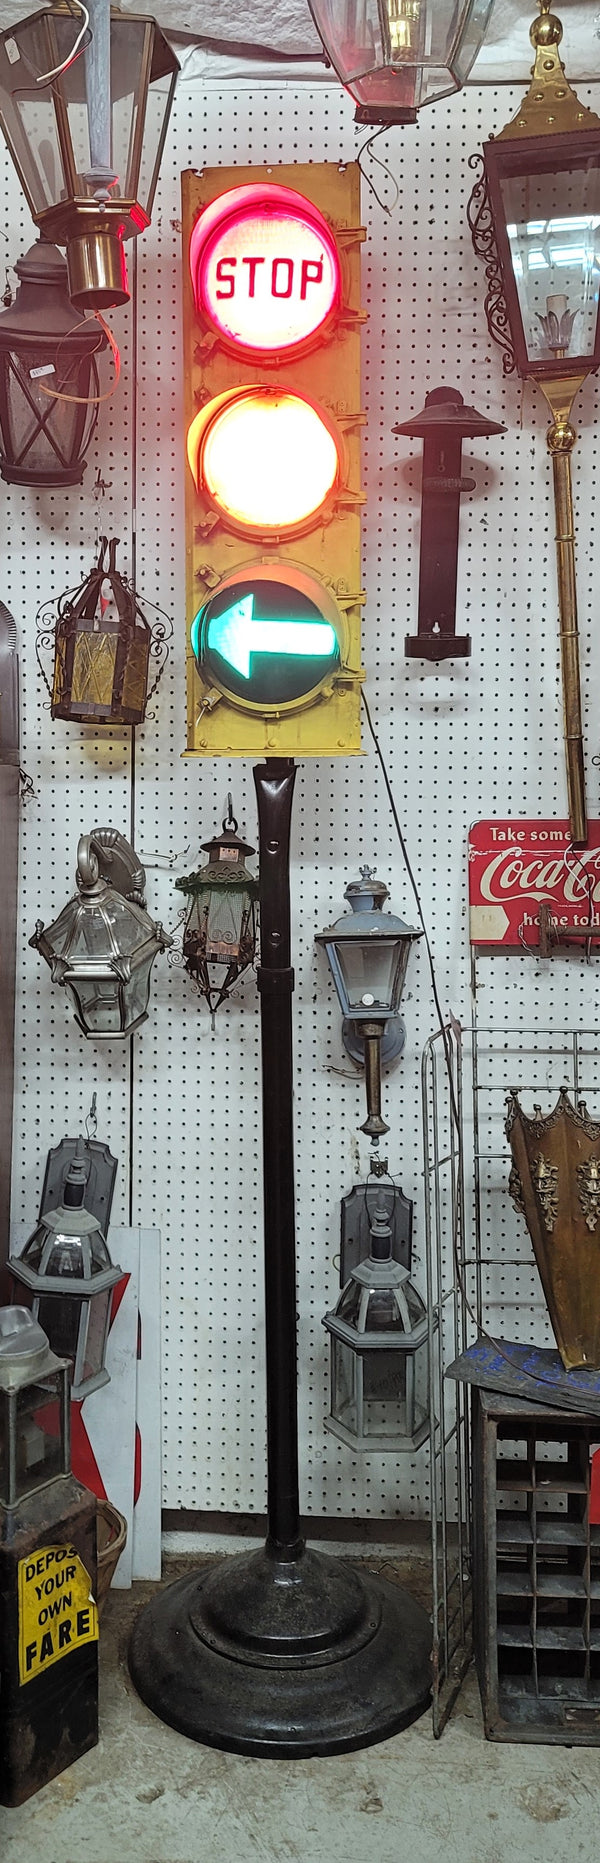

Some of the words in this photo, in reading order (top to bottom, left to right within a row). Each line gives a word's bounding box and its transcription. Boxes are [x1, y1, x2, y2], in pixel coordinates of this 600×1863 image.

[216, 256, 323, 300] STOP
[489, 827, 526, 841] Take
[25, 1546, 78, 1582] DEPOS
[34, 1565, 77, 1601] YOUR
[38, 1591, 73, 1626] OWN
[25, 1608, 90, 1672] FARE
